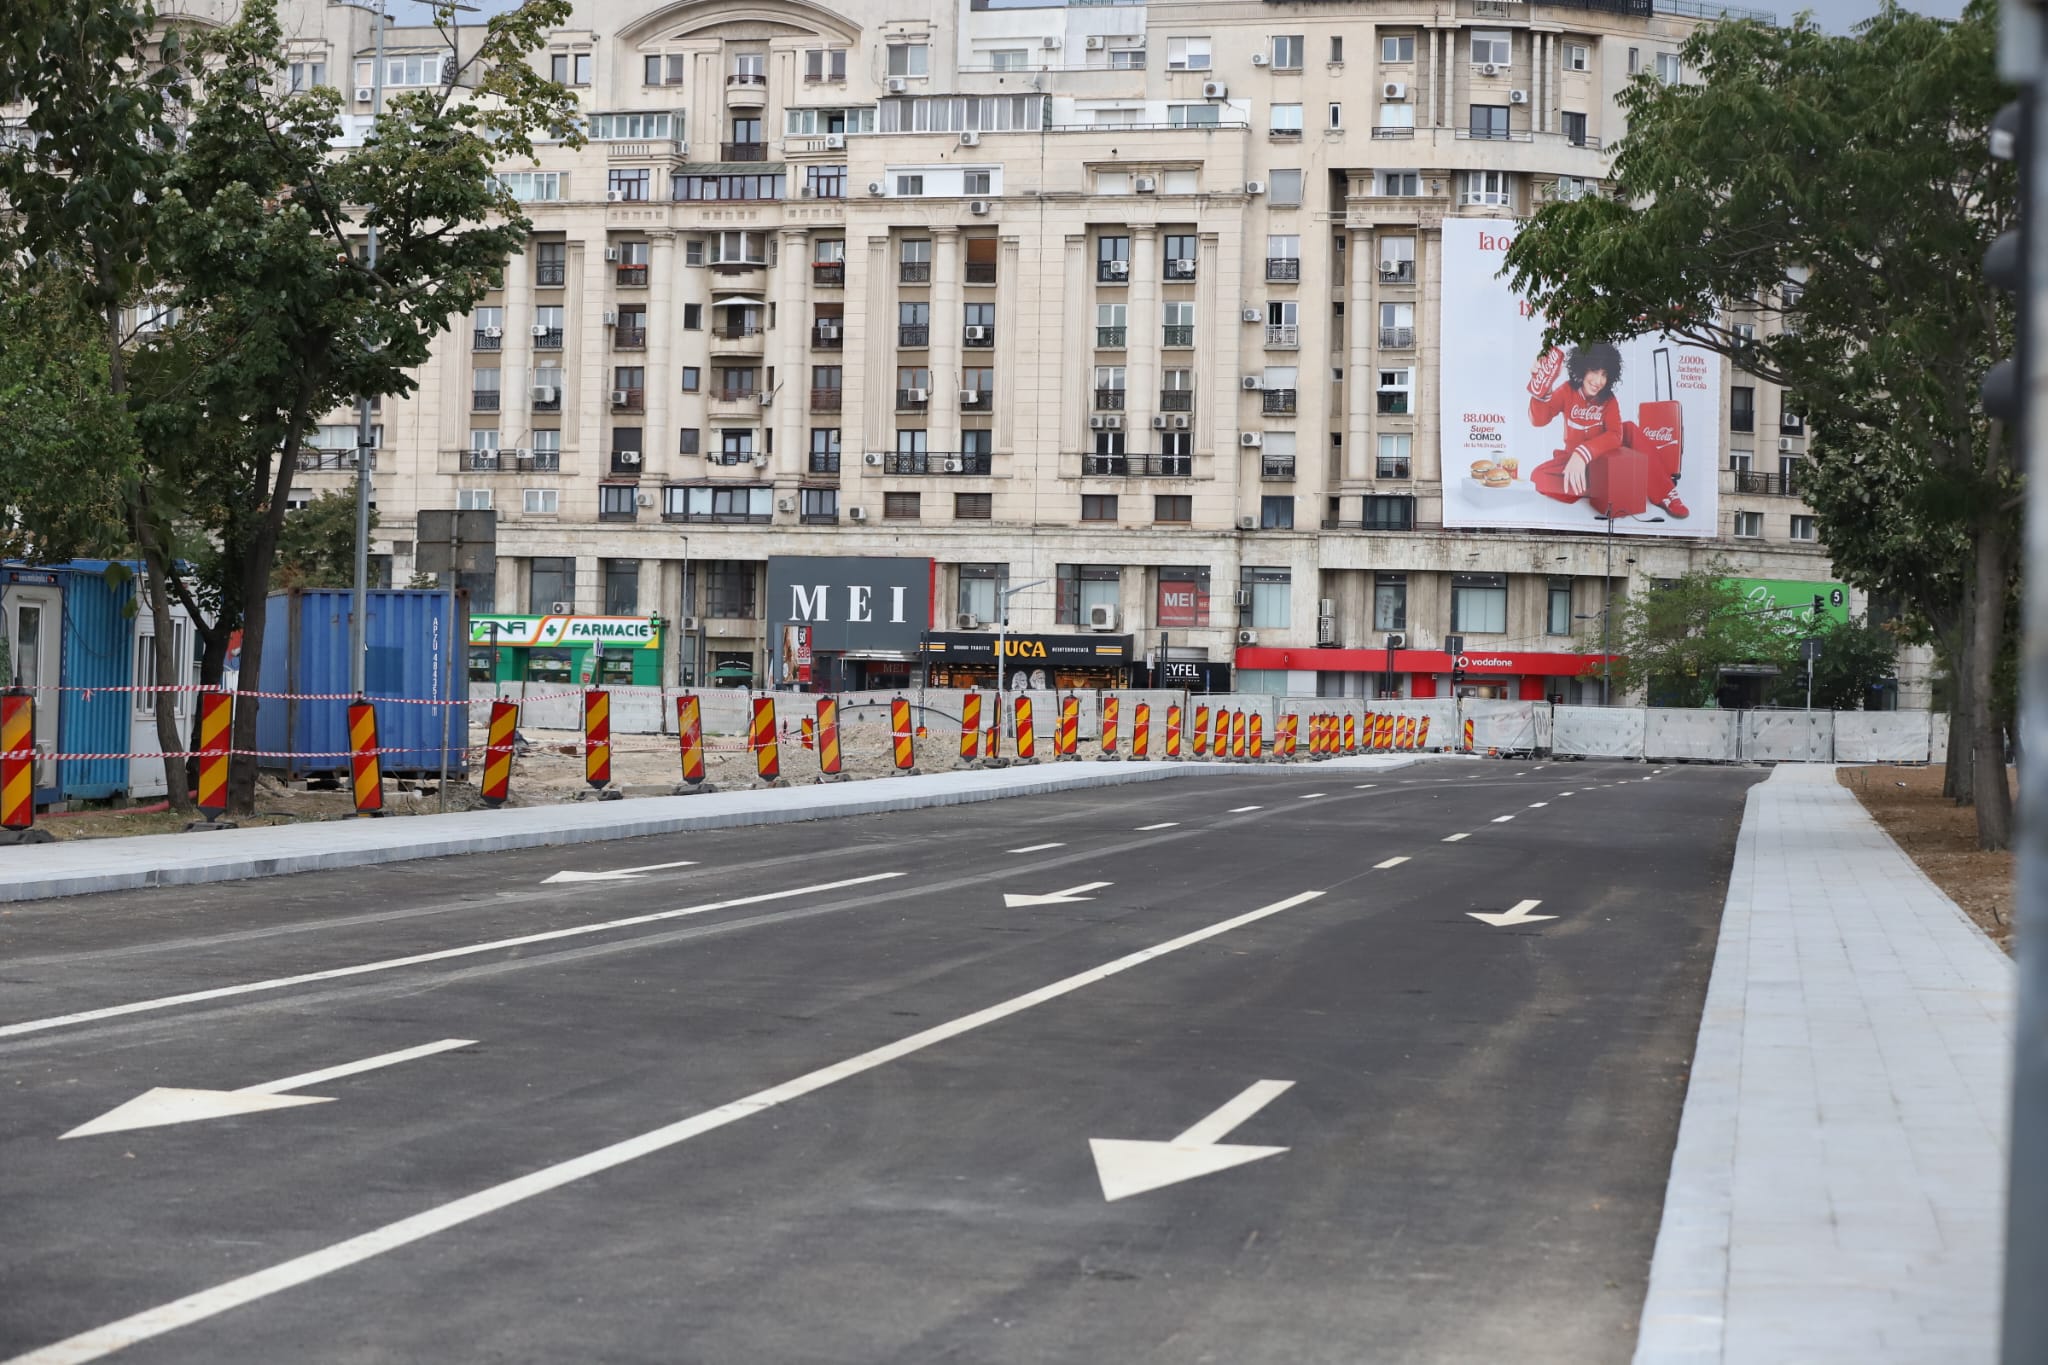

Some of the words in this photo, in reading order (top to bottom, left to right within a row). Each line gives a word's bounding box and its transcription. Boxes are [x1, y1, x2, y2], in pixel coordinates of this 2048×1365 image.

[1463, 413, 1505, 424] 88.000x
[1571, 404, 1604, 421] Coca-Cola
[1471, 425, 1495, 434] Super
[1642, 427, 1674, 441] Coca-Cola
[1164, 592, 1195, 607] MEI
[1834, 591, 1841, 602] 5
[572, 623, 649, 638] FARMACIE
[1471, 658, 1512, 667] vodafone
